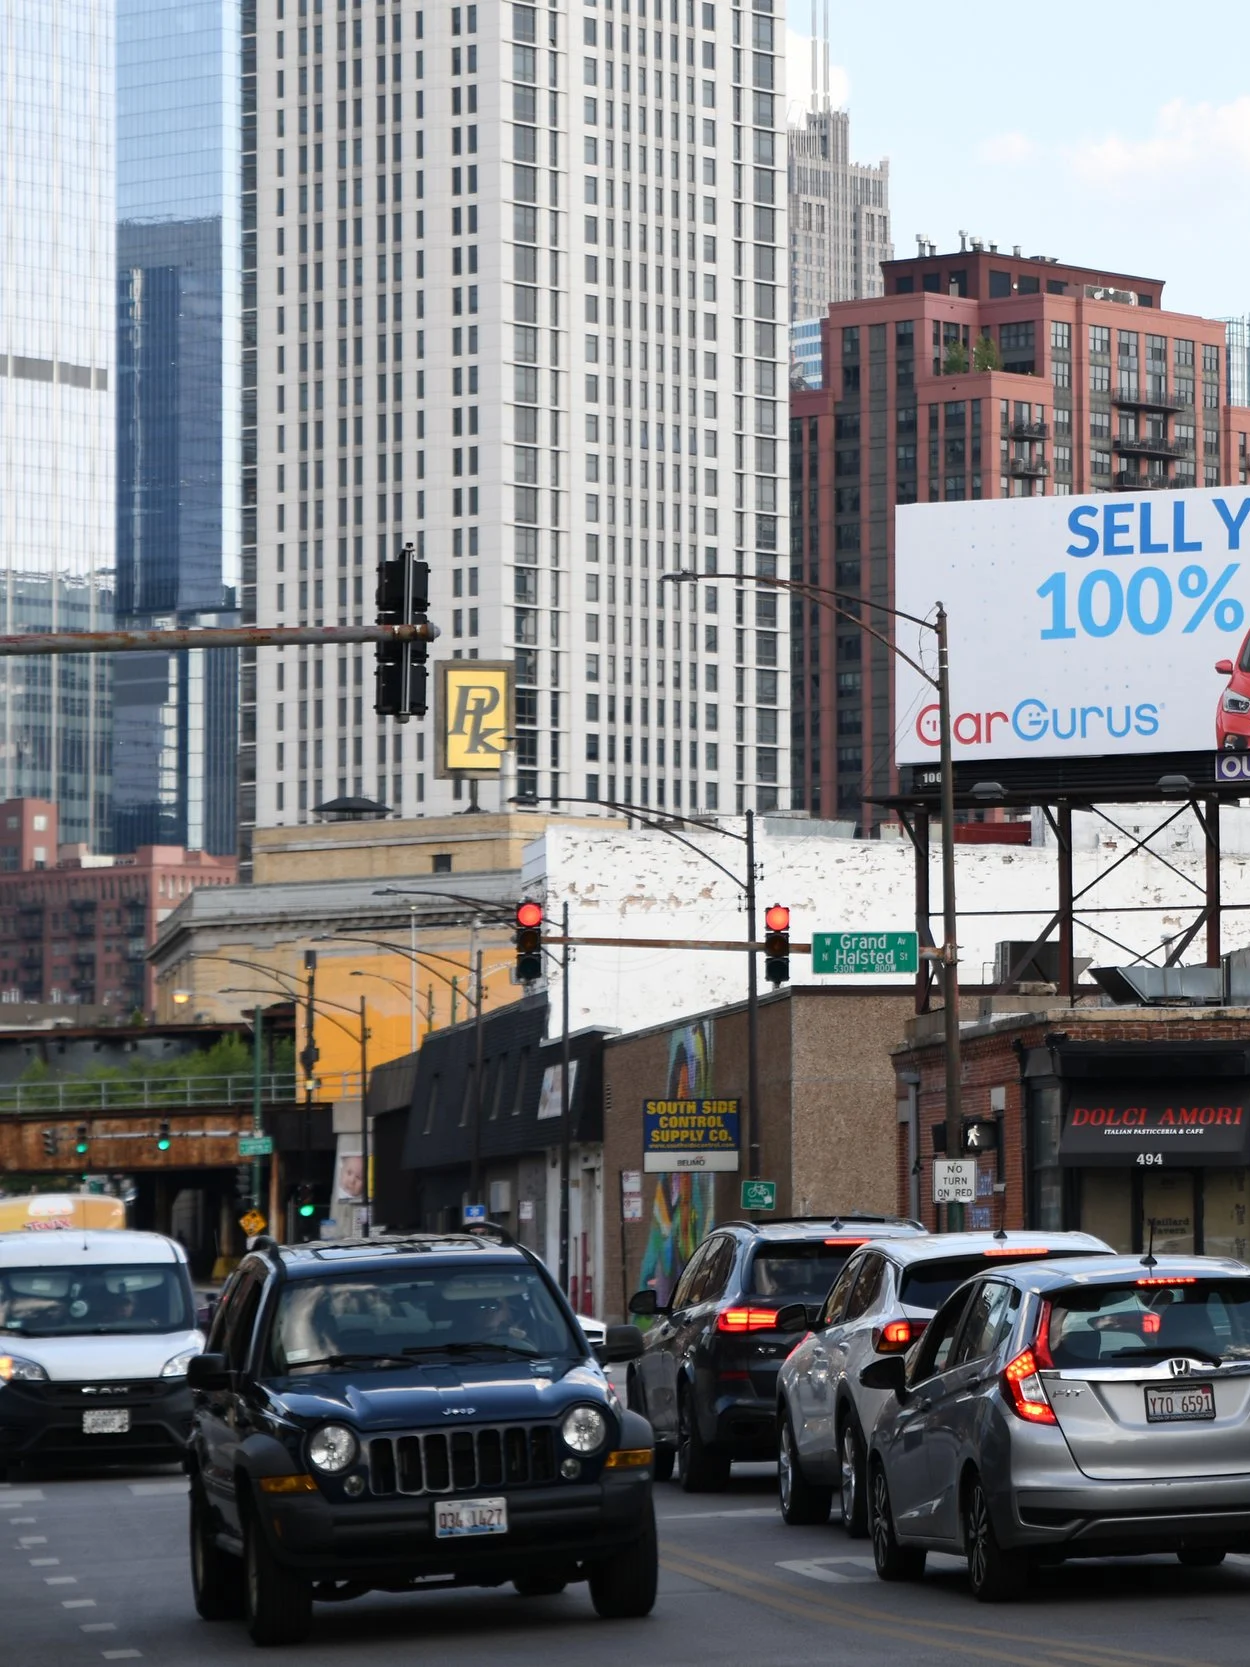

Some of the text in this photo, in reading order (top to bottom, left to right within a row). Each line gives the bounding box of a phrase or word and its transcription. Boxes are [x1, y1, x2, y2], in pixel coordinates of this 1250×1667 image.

[1066, 501, 1202, 558] SELL
[1036, 563, 1245, 640] 100%
[916, 698, 1159, 746] CarGurus
[840, 934, 887, 949] Grand
[897, 937, 906, 945] Av
[822, 953, 828, 961] N
[836, 949, 894, 965] Halsted
[834, 964, 854, 972] 530N
[875, 964, 896, 972] 800W
[646, 1101, 737, 1114] SOUTH SIDE
[659, 1116, 724, 1128] CONTROL
[1072, 1107, 1243, 1126] DOLCI AMORI
[651, 1130, 732, 1142] SUPPLY CO.
[1136, 1153, 1163, 1165] 494
[943, 1177, 967, 1185] TURN
[937, 1189, 949, 1197] ON
[1052, 1389, 1085, 1398] FIT
[1150, 1395, 1212, 1414] Y70 6591
